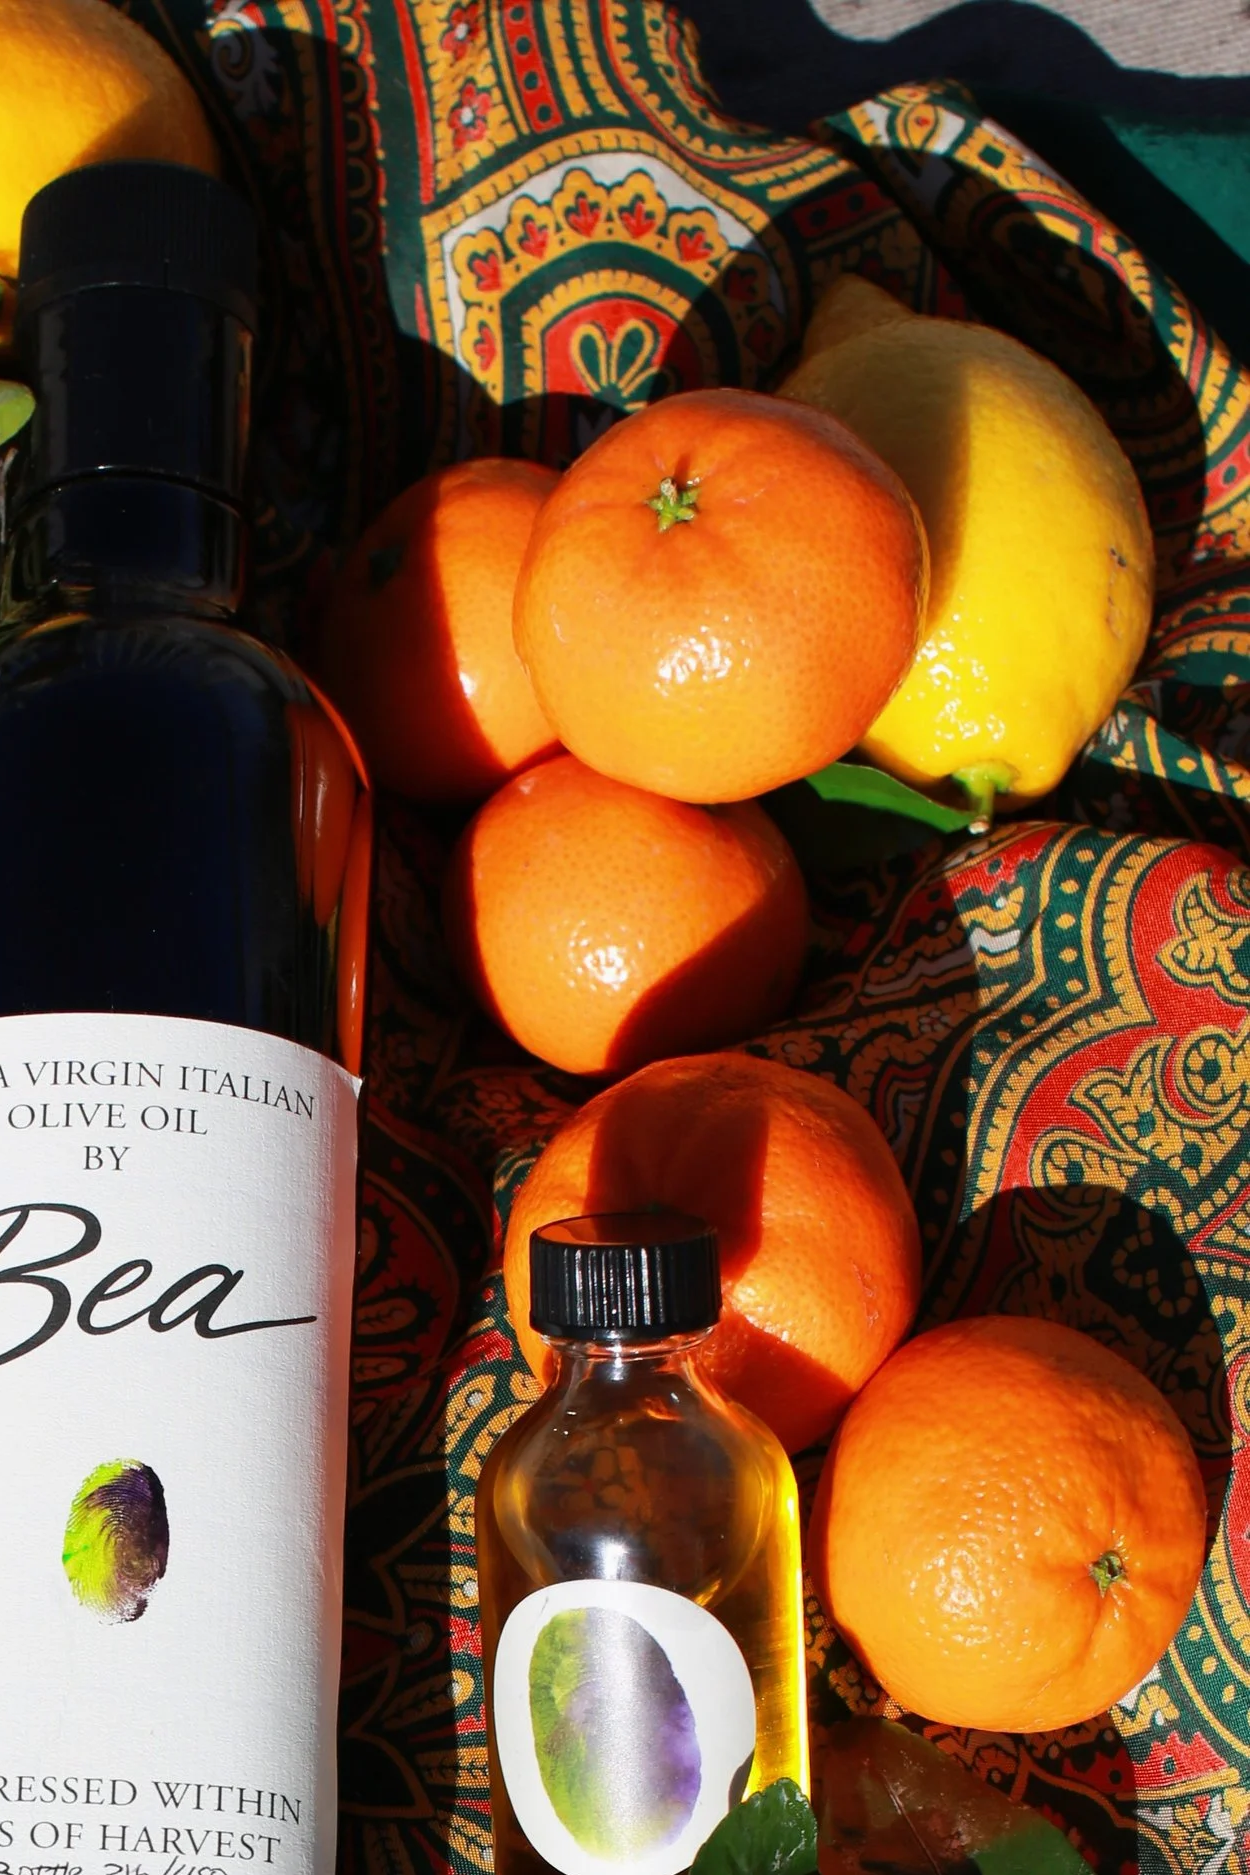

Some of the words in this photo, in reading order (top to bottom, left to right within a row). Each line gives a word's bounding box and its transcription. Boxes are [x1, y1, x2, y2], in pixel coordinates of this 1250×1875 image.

[23, 1060, 163, 1089] VIRGIN
[178, 1065, 316, 1120] ITALIAN
[7, 1102, 125, 1130] OLIVE
[140, 1106, 208, 1135] OIL
[82, 1145, 132, 1171] BY
[152, 1780, 303, 1826] WITHIN
[29, 1821, 84, 1850] OF
[98, 1824, 282, 1865] HARVEST
